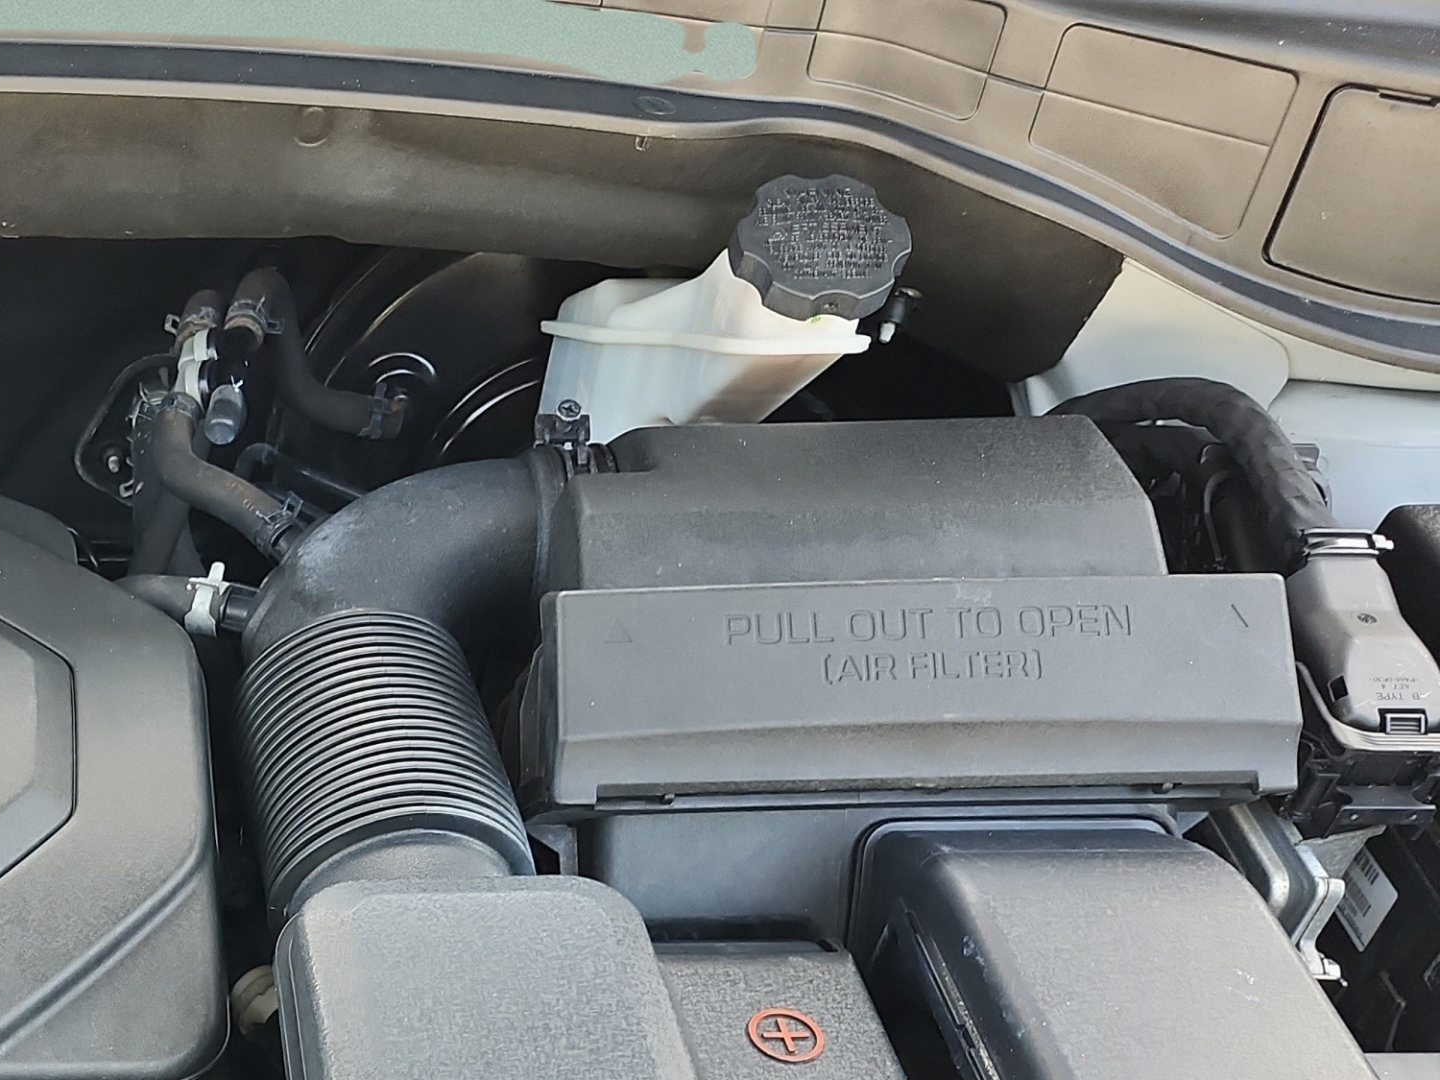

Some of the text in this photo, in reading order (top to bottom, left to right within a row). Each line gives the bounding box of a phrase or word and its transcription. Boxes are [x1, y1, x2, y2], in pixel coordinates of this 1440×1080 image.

[724, 604, 1131, 646] PULL OUT TO OPEN
[823, 649, 1043, 685] (AIR FILTER)
[1375, 692, 1404, 700] TYPE
